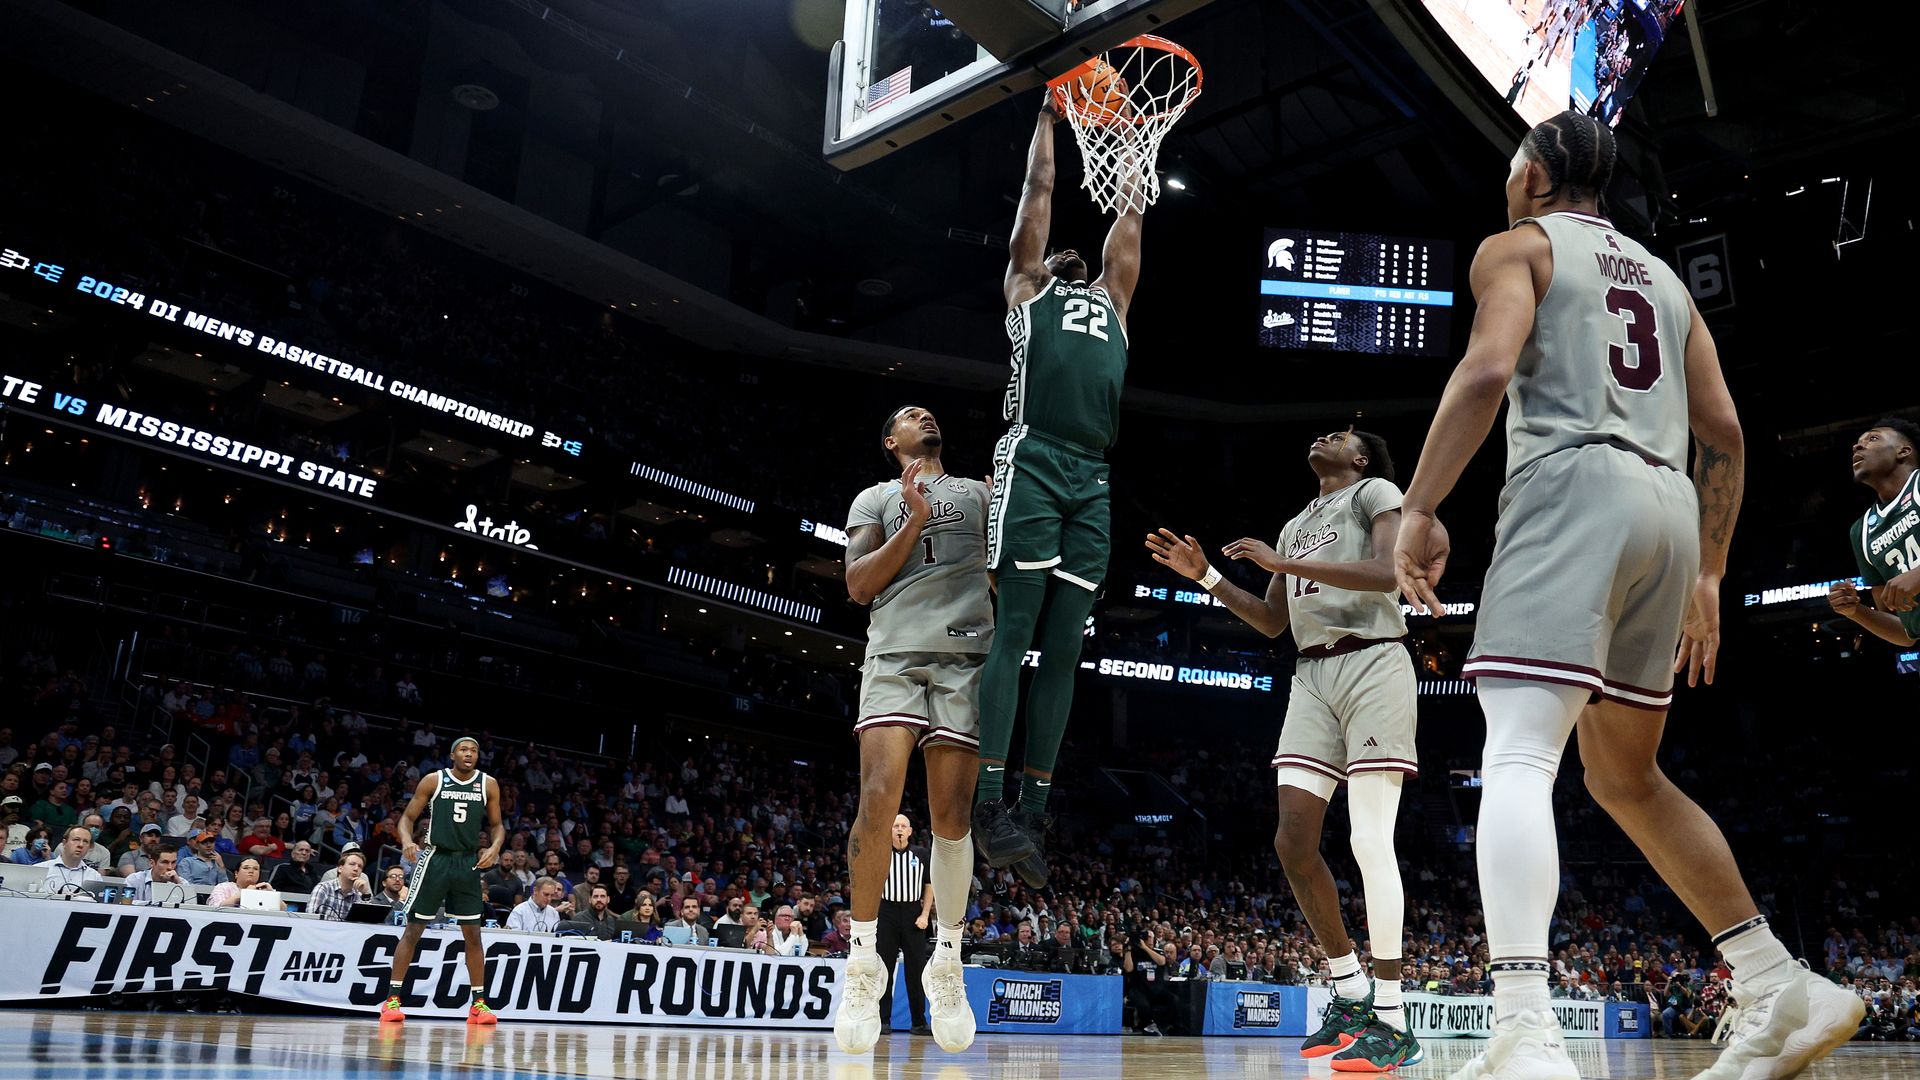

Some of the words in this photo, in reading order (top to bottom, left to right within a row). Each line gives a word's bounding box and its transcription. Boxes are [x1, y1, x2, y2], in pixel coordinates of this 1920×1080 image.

[1594, 252, 1653, 286] MOORE
[1688, 253, 1724, 299] 6
[1062, 299, 1109, 343] 22
[1605, 283, 1664, 393] 3
[77, 275, 146, 310] 2024
[149, 299, 181, 322] DI
[183, 311, 255, 347] MEN'S
[257, 335, 385, 391] BASKETBALL
[389, 380, 535, 439] CHAMPIONSHIP
[53, 392, 88, 416] VS
[95, 403, 295, 475] MISSISSIPPI
[298, 460, 378, 499] STATE
[1288, 522, 1339, 560] State
[1869, 509, 1920, 556] SPARTANS
[922, 536, 937, 566] 1
[1884, 533, 1920, 574] 34
[1174, 590, 1211, 606] 2024
[1098, 658, 1174, 681] SECOND
[1177, 667, 1253, 690] ROUNDS
[440, 790, 482, 802] SPARTANS
[452, 802, 468, 823] 5
[39, 911, 292, 996] FIRST
[280, 950, 345, 984] AND
[349, 932, 602, 1013] SECOND
[615, 952, 836, 1020] ROUNDS
[1004, 982, 1043, 1000] MARCH
[1244, 993, 1269, 1008] MARCH
[1009, 1000, 1061, 1017] MADNESS
[1247, 1008, 1280, 1023] MADNESS
[1430, 1003, 1444, 1029] OF
[1447, 1004, 1484, 1030] NORTH
